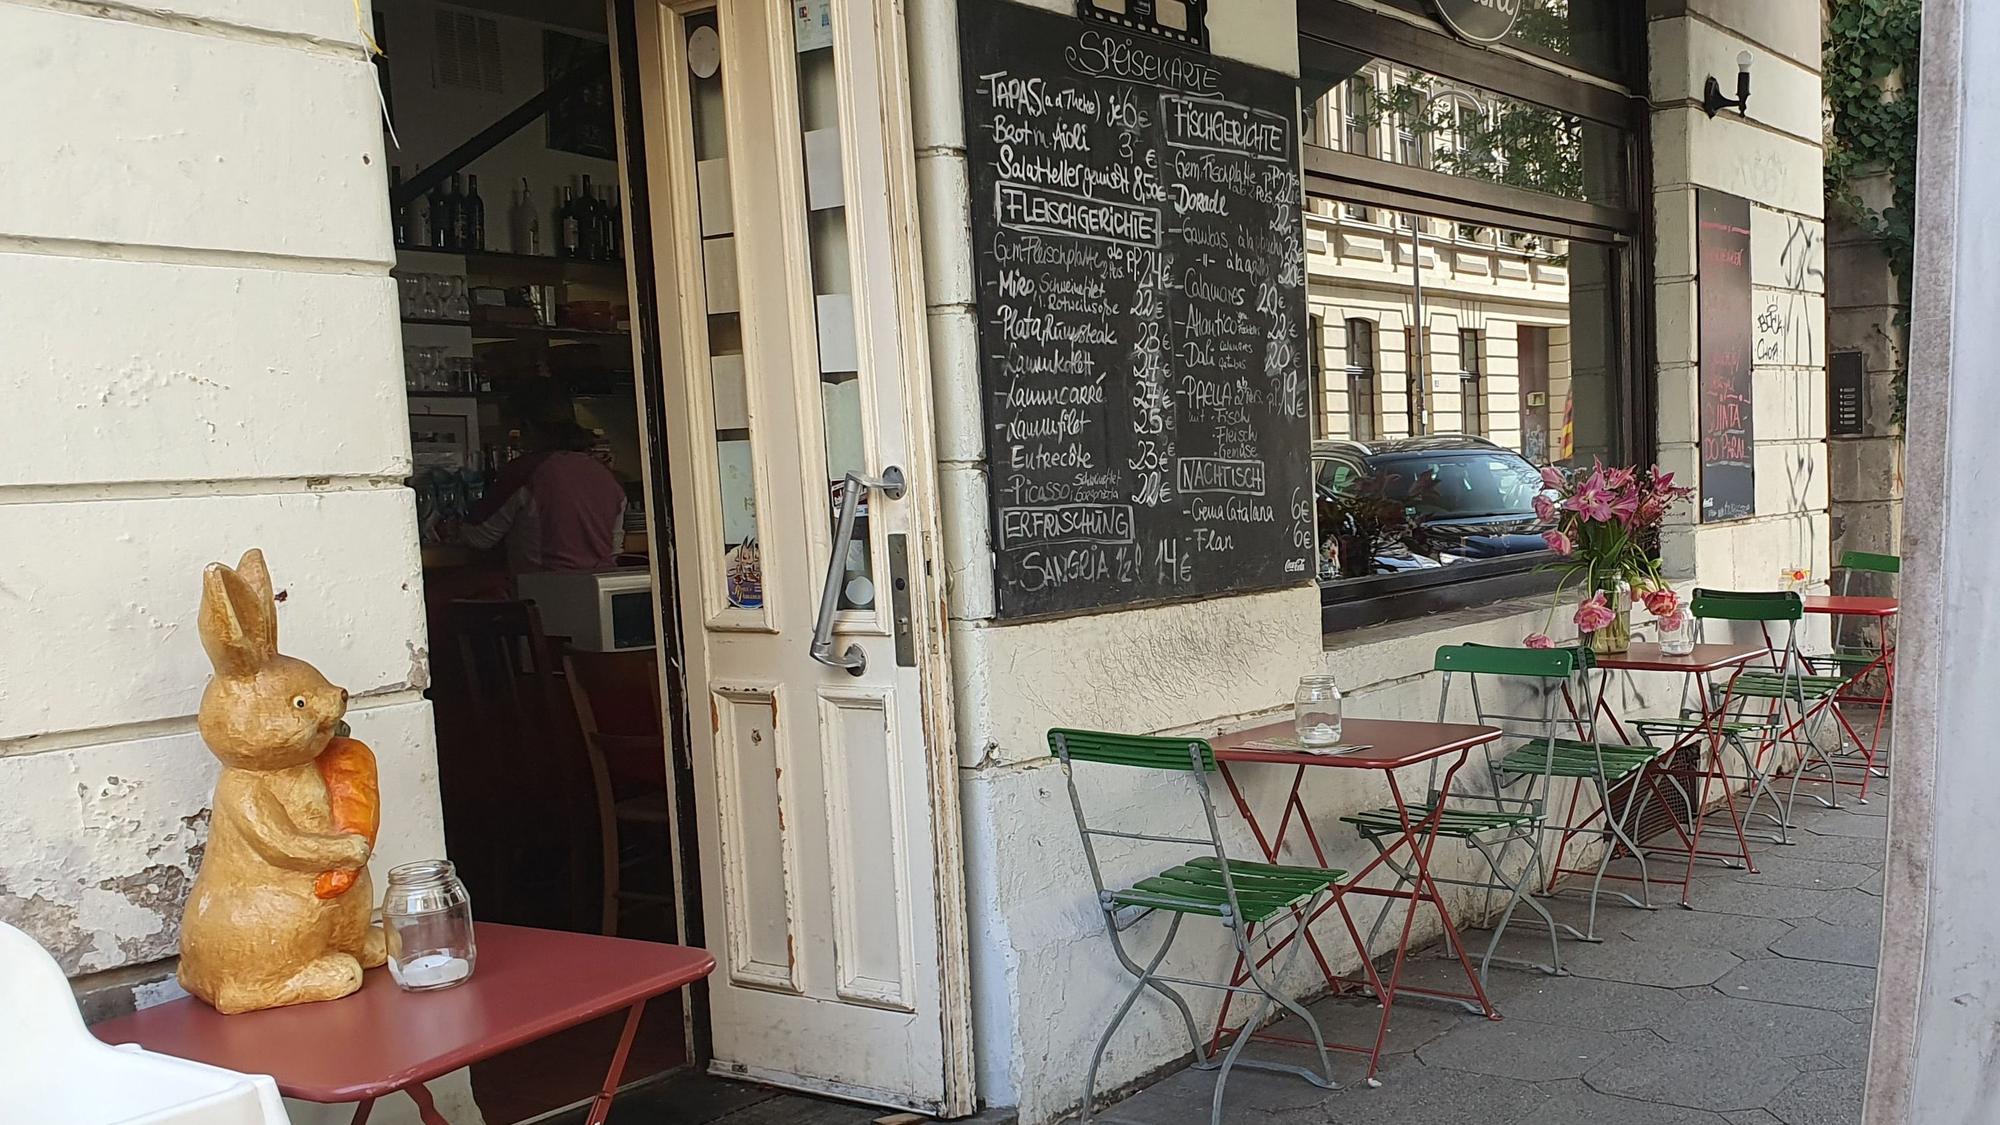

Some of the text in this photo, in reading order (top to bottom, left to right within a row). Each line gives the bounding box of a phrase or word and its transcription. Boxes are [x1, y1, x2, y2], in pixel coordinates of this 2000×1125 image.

[980, 71, 1042, 117] TAPAS
[1053, 121, 1091, 153] Aioli
[1171, 184, 1229, 217] Dorade
[1183, 460, 1262, 490] NACHTISCH
[1193, 528, 1234, 552] Flan
